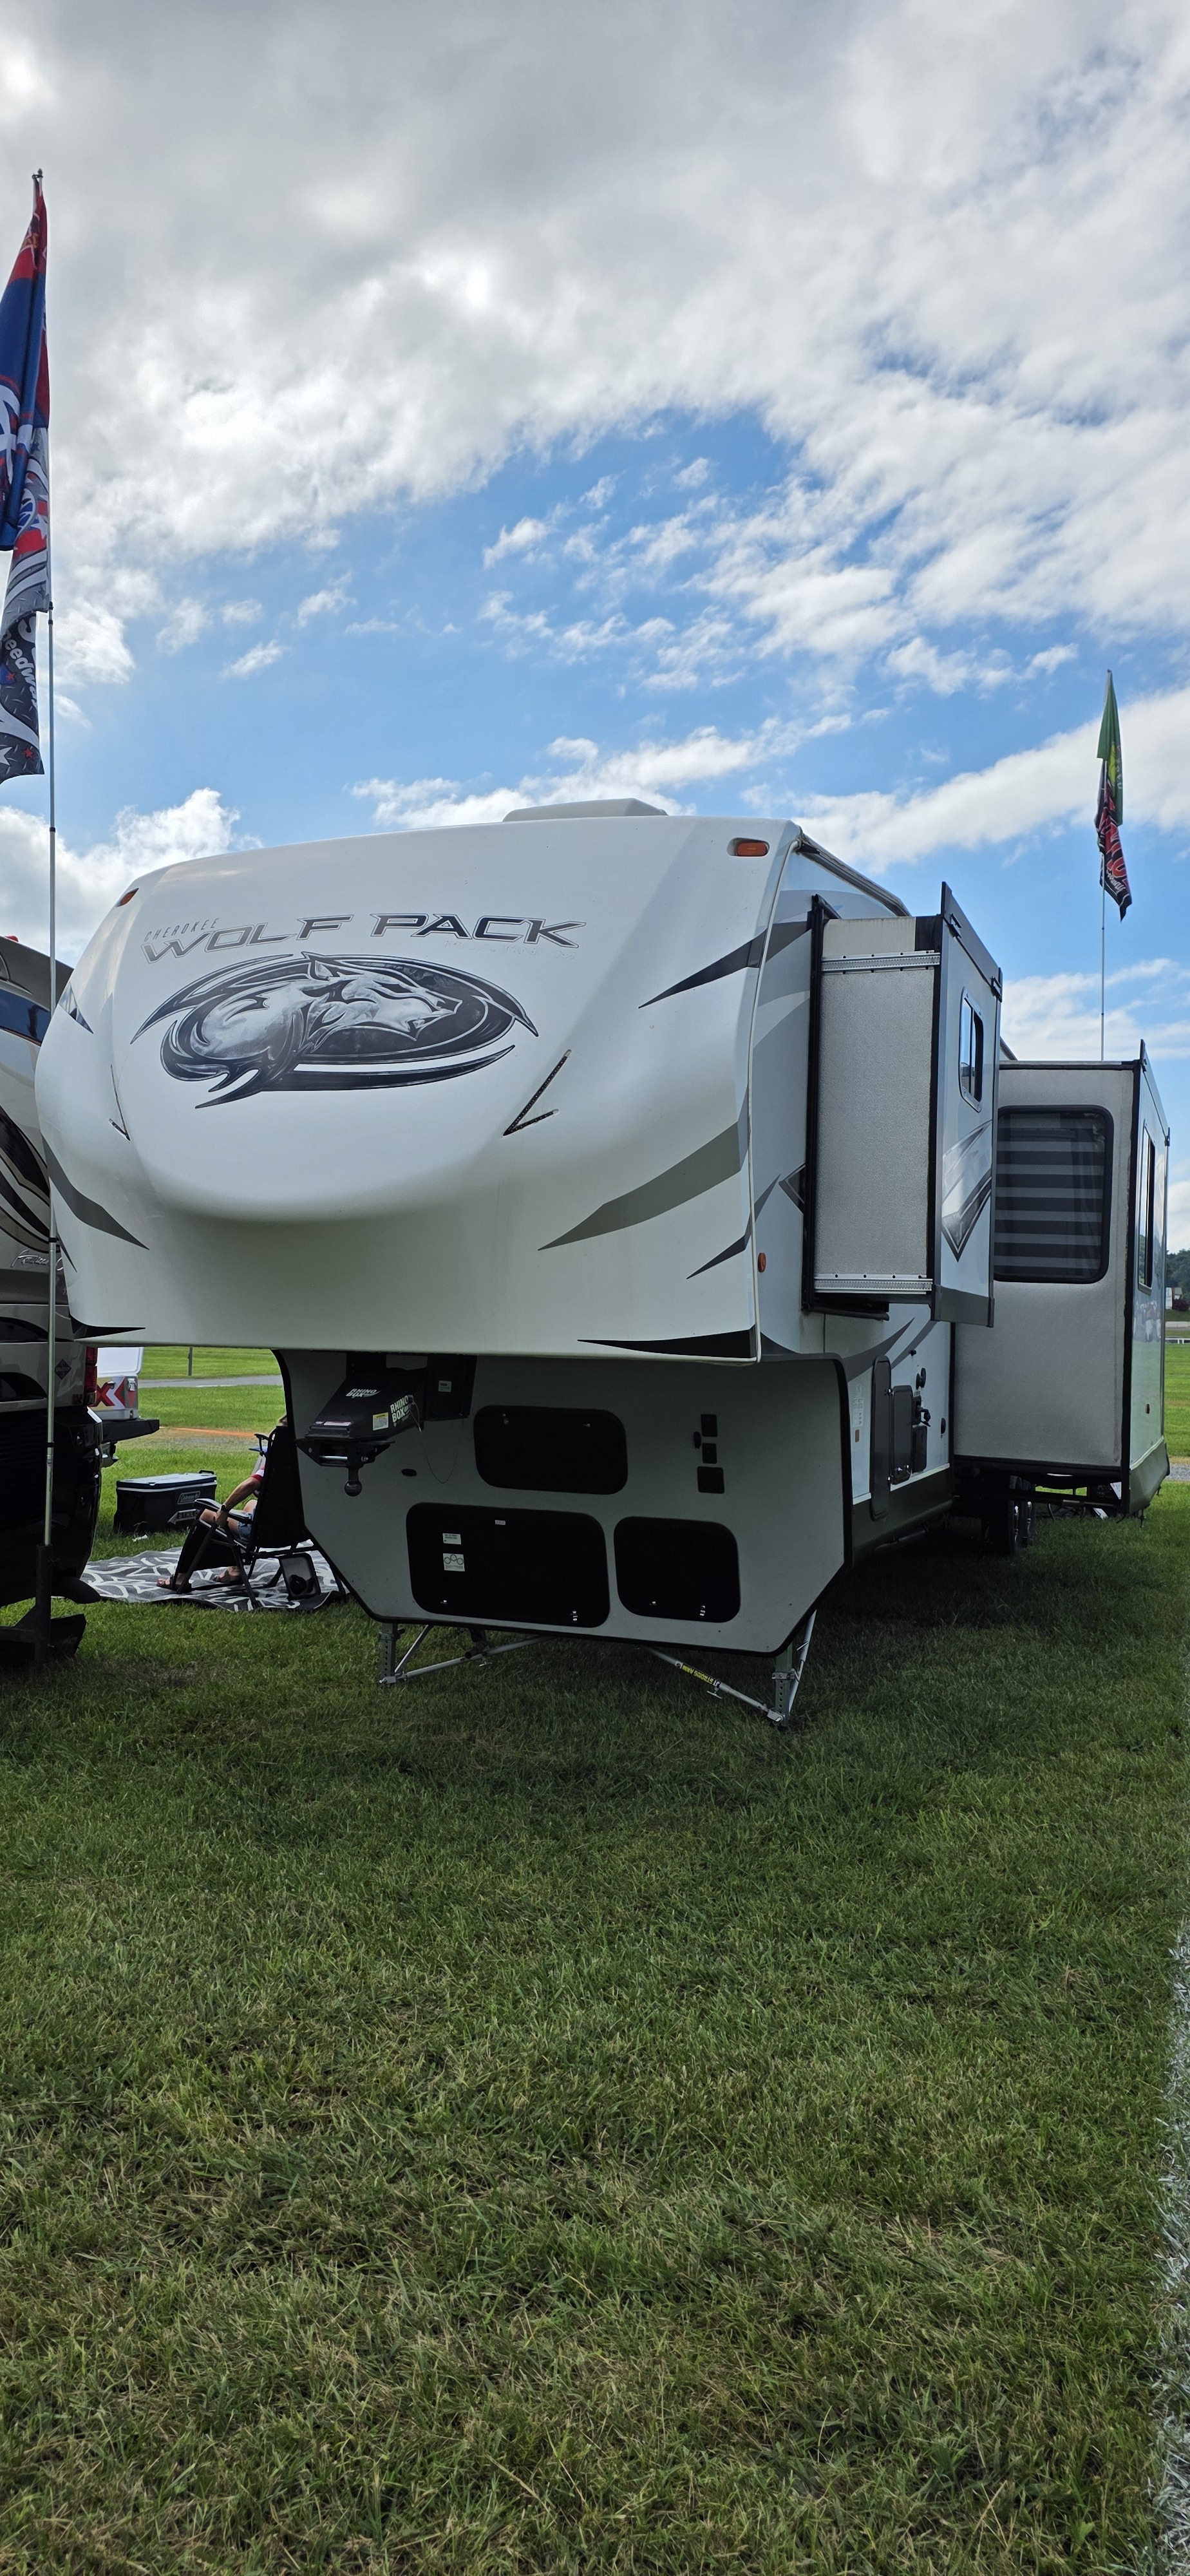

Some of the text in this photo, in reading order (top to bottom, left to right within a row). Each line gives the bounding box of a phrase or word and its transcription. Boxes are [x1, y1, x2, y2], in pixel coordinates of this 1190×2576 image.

[141, 913, 586, 963] WOLF PACK
[144, 918, 220, 942] CHEROKEE
[390, 1395, 409, 1413] RHINO
[392, 1408, 406, 1423] BOX
